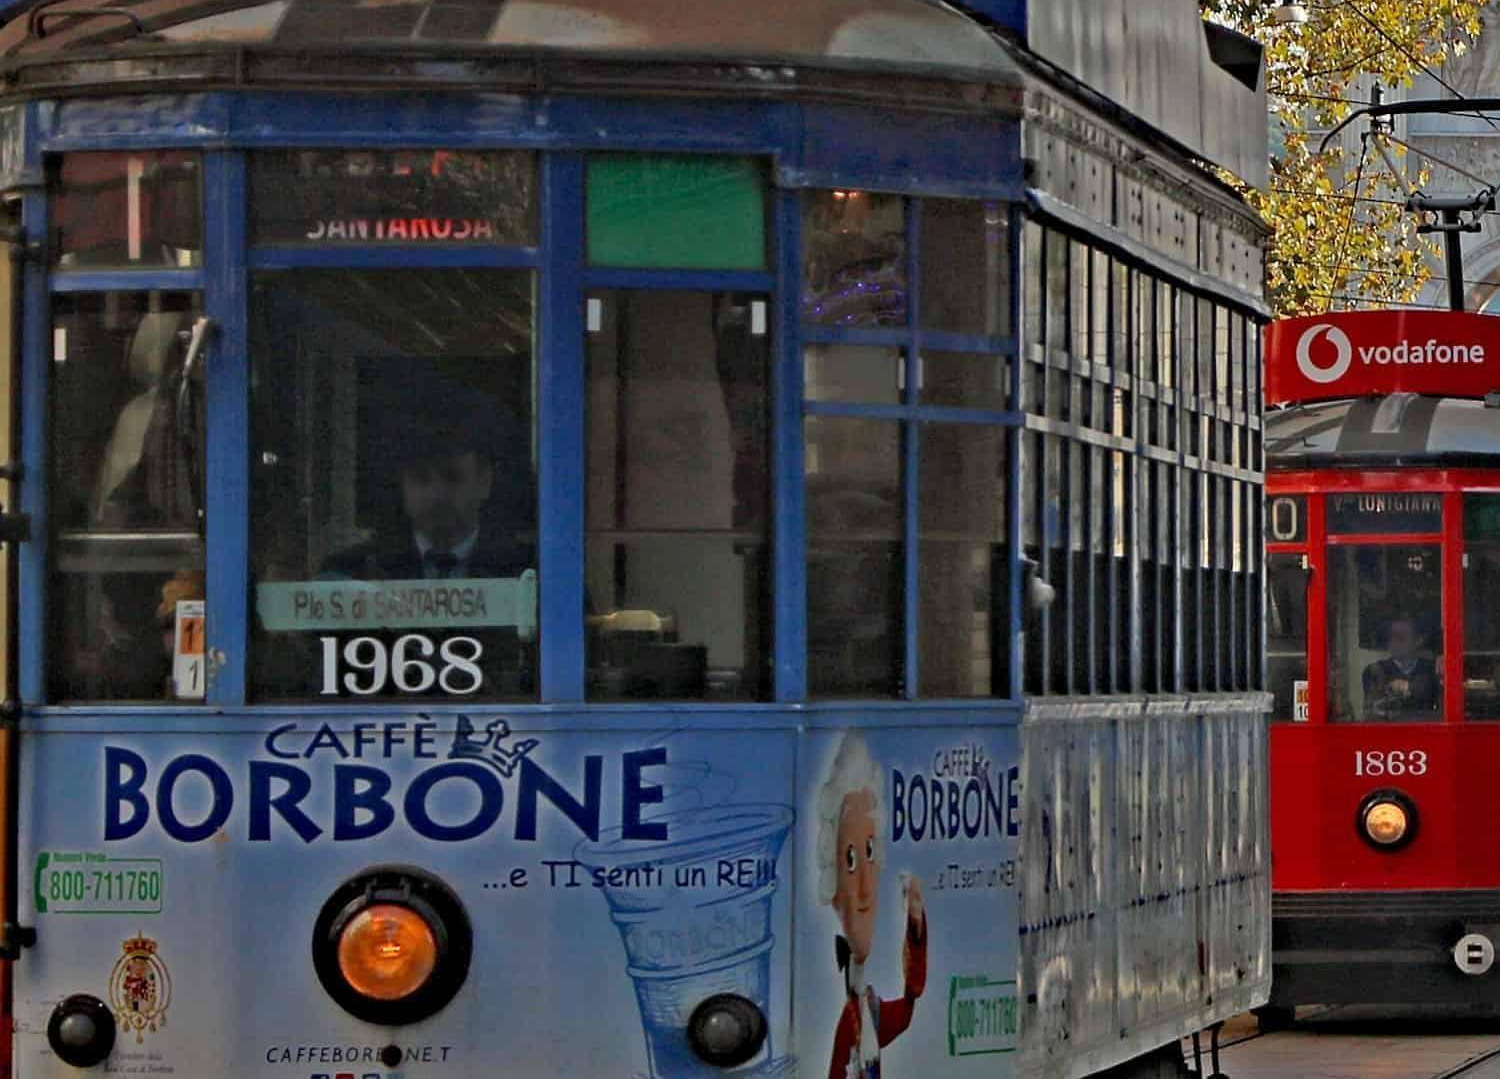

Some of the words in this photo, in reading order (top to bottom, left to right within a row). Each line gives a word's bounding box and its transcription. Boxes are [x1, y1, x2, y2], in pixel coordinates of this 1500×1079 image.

[1358, 339, 1485, 365] vodafone
[374, 587, 488, 620] SANTAROSA
[319, 633, 484, 695] 1968
[263, 713, 439, 760] CAFFÈ
[1355, 750, 1428, 777] 1863
[103, 746, 670, 844] BORBONE
[892, 766, 1019, 843] BORBONE
[49, 870, 161, 901] 800-711760
[541, 860, 582, 888] TI
[591, 860, 664, 888] senti
[674, 866, 707, 888] un
